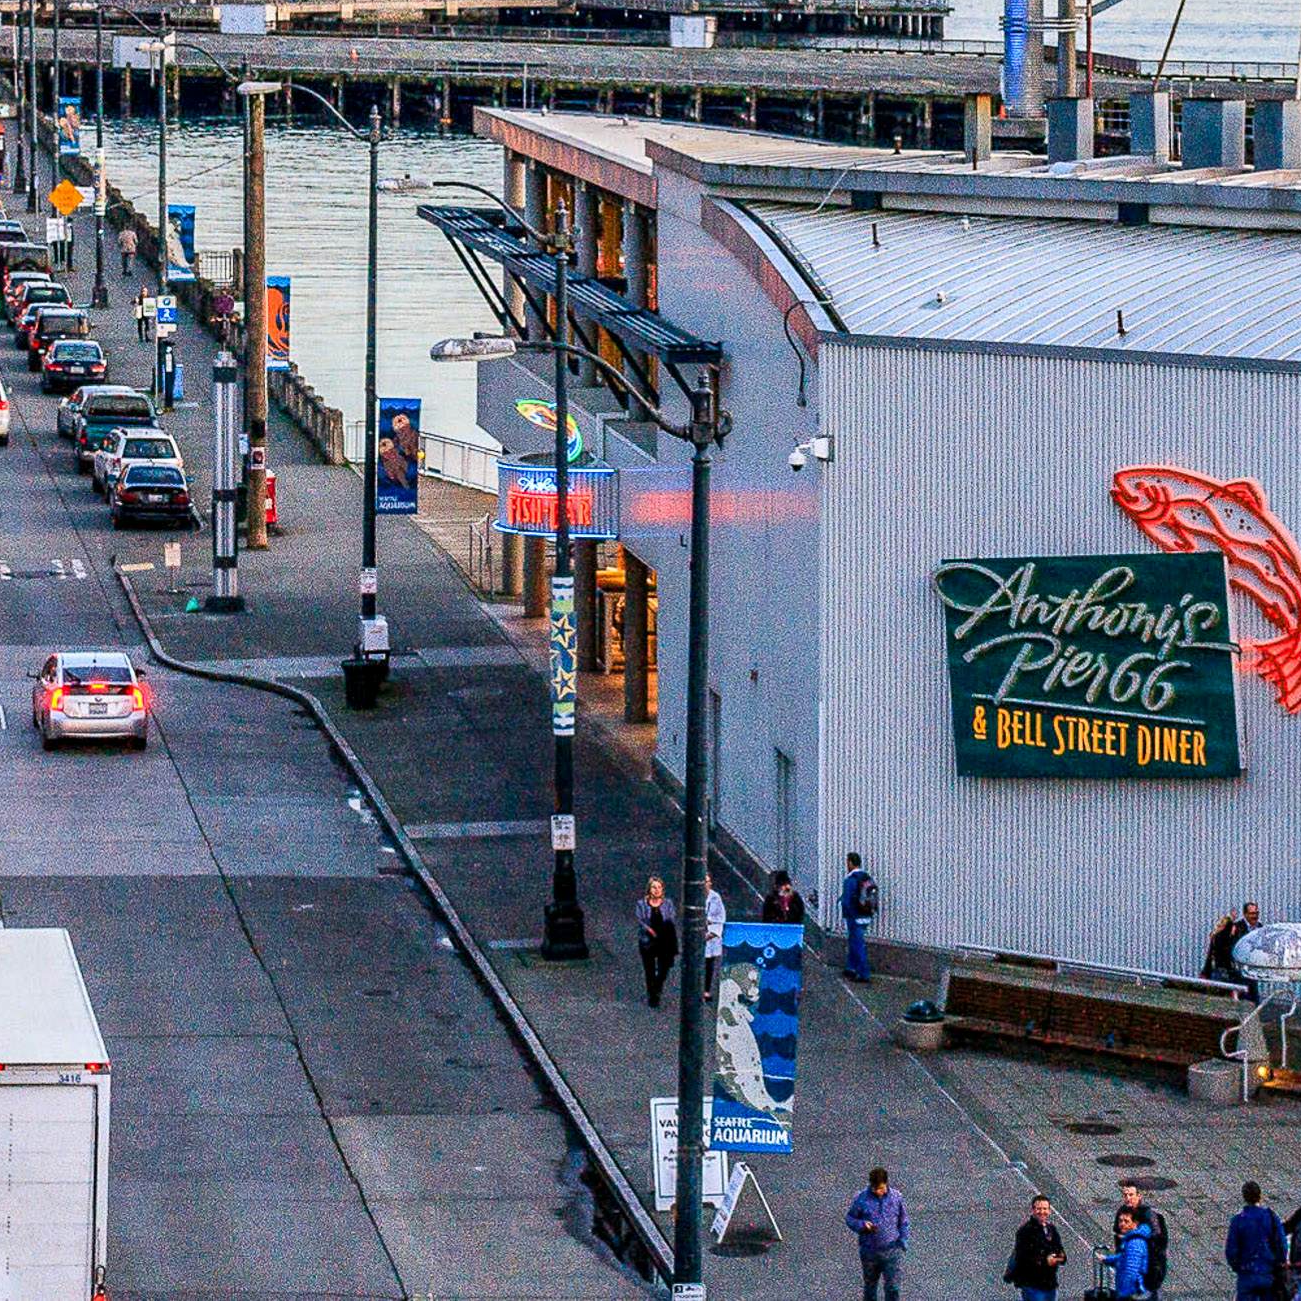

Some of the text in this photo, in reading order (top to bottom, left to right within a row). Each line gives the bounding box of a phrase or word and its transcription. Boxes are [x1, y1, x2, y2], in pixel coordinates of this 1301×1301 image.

[932, 561, 1241, 659] Anthony's
[962, 631, 1191, 713] Pier 66
[972, 705, 1208, 767] & BELL STREET DINER
[713, 1128, 789, 1146] AQUARIUM
[714, 1117, 753, 1128] SEATTLE
